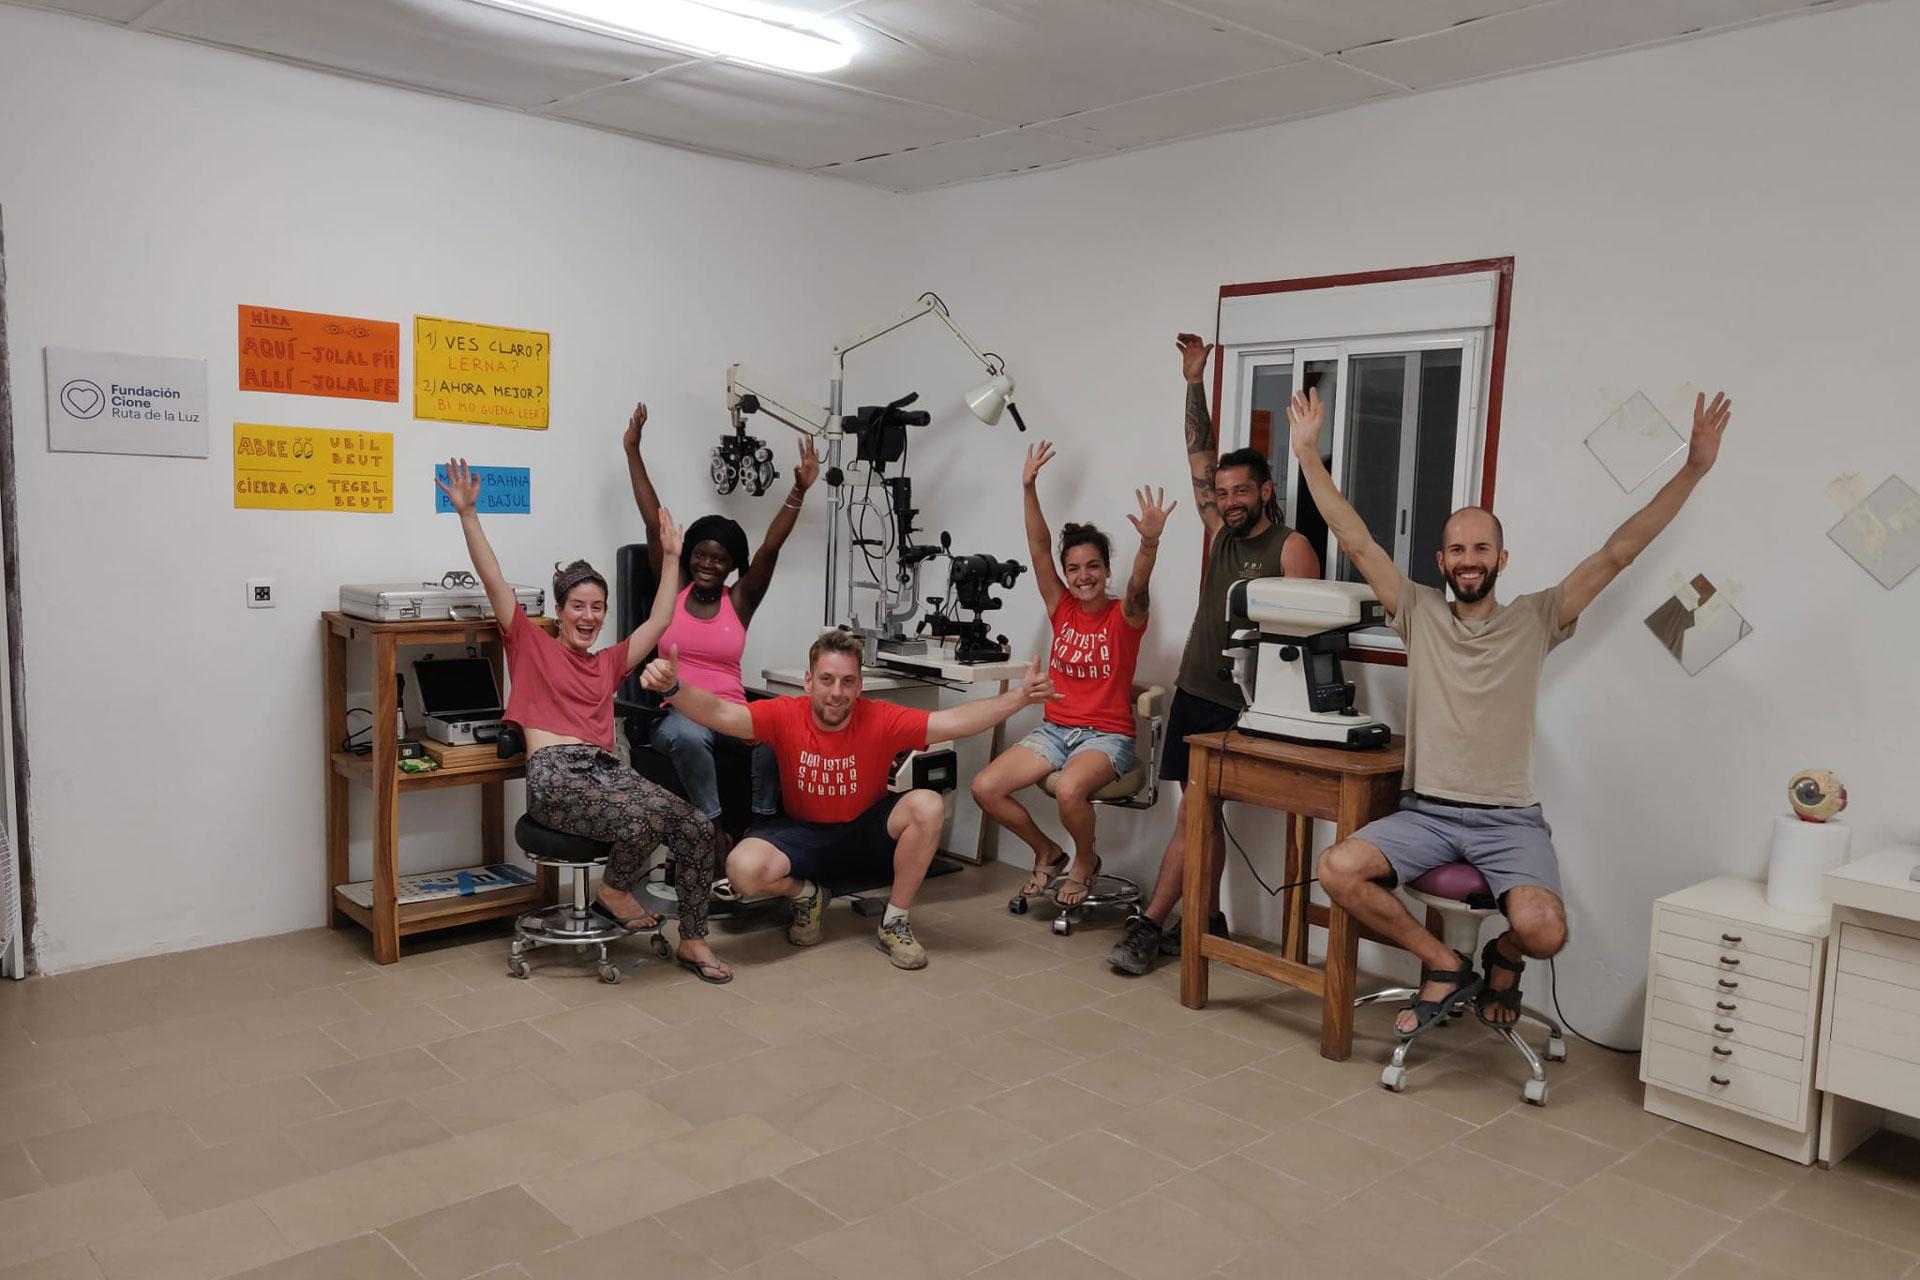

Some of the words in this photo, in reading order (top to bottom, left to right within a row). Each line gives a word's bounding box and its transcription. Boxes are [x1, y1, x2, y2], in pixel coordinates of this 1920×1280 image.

[242, 337, 298, 361] AQUÍ
[445, 336, 479, 352] VES
[244, 367, 296, 390] ALLÍ
[111, 384, 181, 399] Fundación
[440, 380, 487, 396] AHORA
[111, 396, 151, 408] Cione
[112, 407, 141, 420] Ruta
[144, 409, 161, 421] de
[164, 410, 175, 422] la
[178, 411, 200, 423] Luz
[237, 436, 289, 458] ABRE
[332, 452, 383, 468] BEUT
[327, 479, 384, 494] TEGEL
[334, 495, 387, 509] BEUT
[487, 494, 529, 508] BAJUL
[800, 750, 856, 771] DENISTAS
